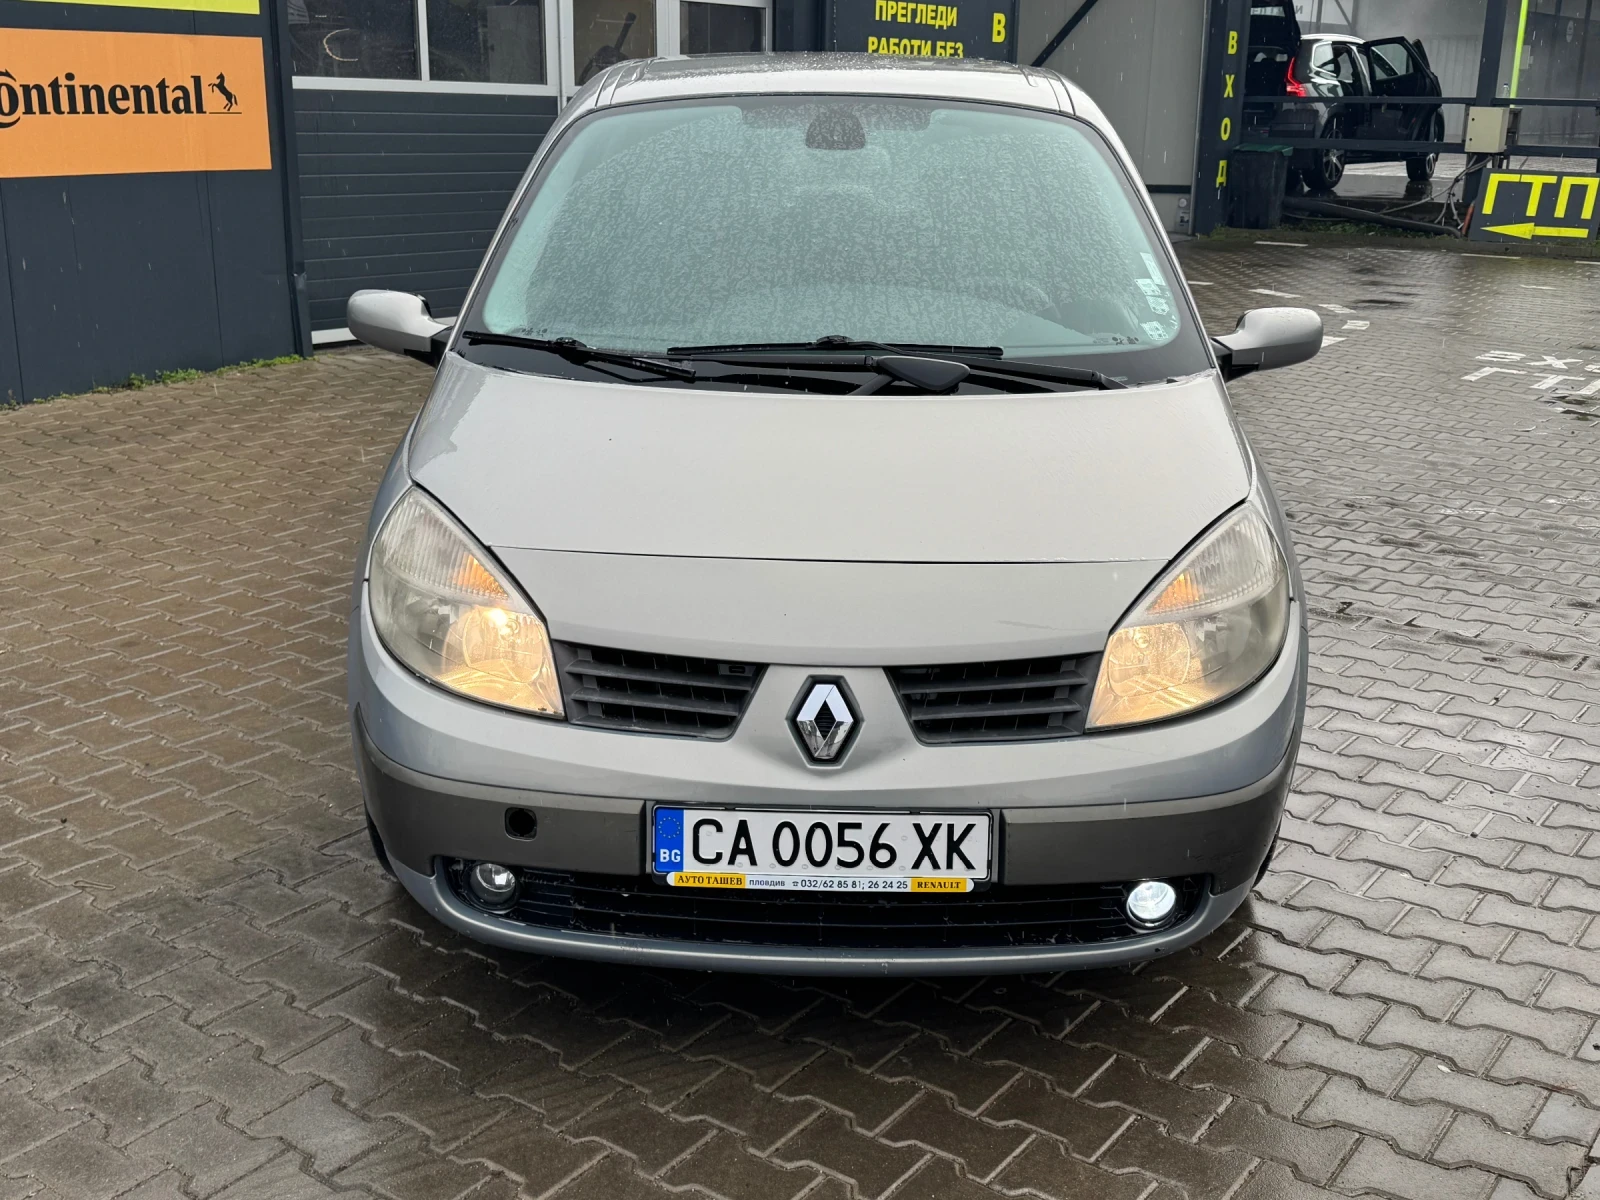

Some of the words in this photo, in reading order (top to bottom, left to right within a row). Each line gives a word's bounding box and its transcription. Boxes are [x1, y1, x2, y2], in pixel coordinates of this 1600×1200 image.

[875, 0, 958, 30] ПРЕГЛЕДИ
[867, 36, 932, 56] РАБОТИ
[936, 40, 964, 58] БЕЗ
[1215, 30, 1238, 188] ВХОД
[1482, 173, 1600, 220] ГТП
[659, 849, 681, 863] BG
[772, 820, 897, 869] 0056
[705, 877, 743, 886] ТАШЕВ
[800, 879, 834, 889] 032/62
[836, 880, 849, 889] 85
[867, 881, 880, 890] 26
[882, 881, 894, 890] 24
[896, 881, 909, 890] 25
[916, 881, 962, 890] RENAULT
